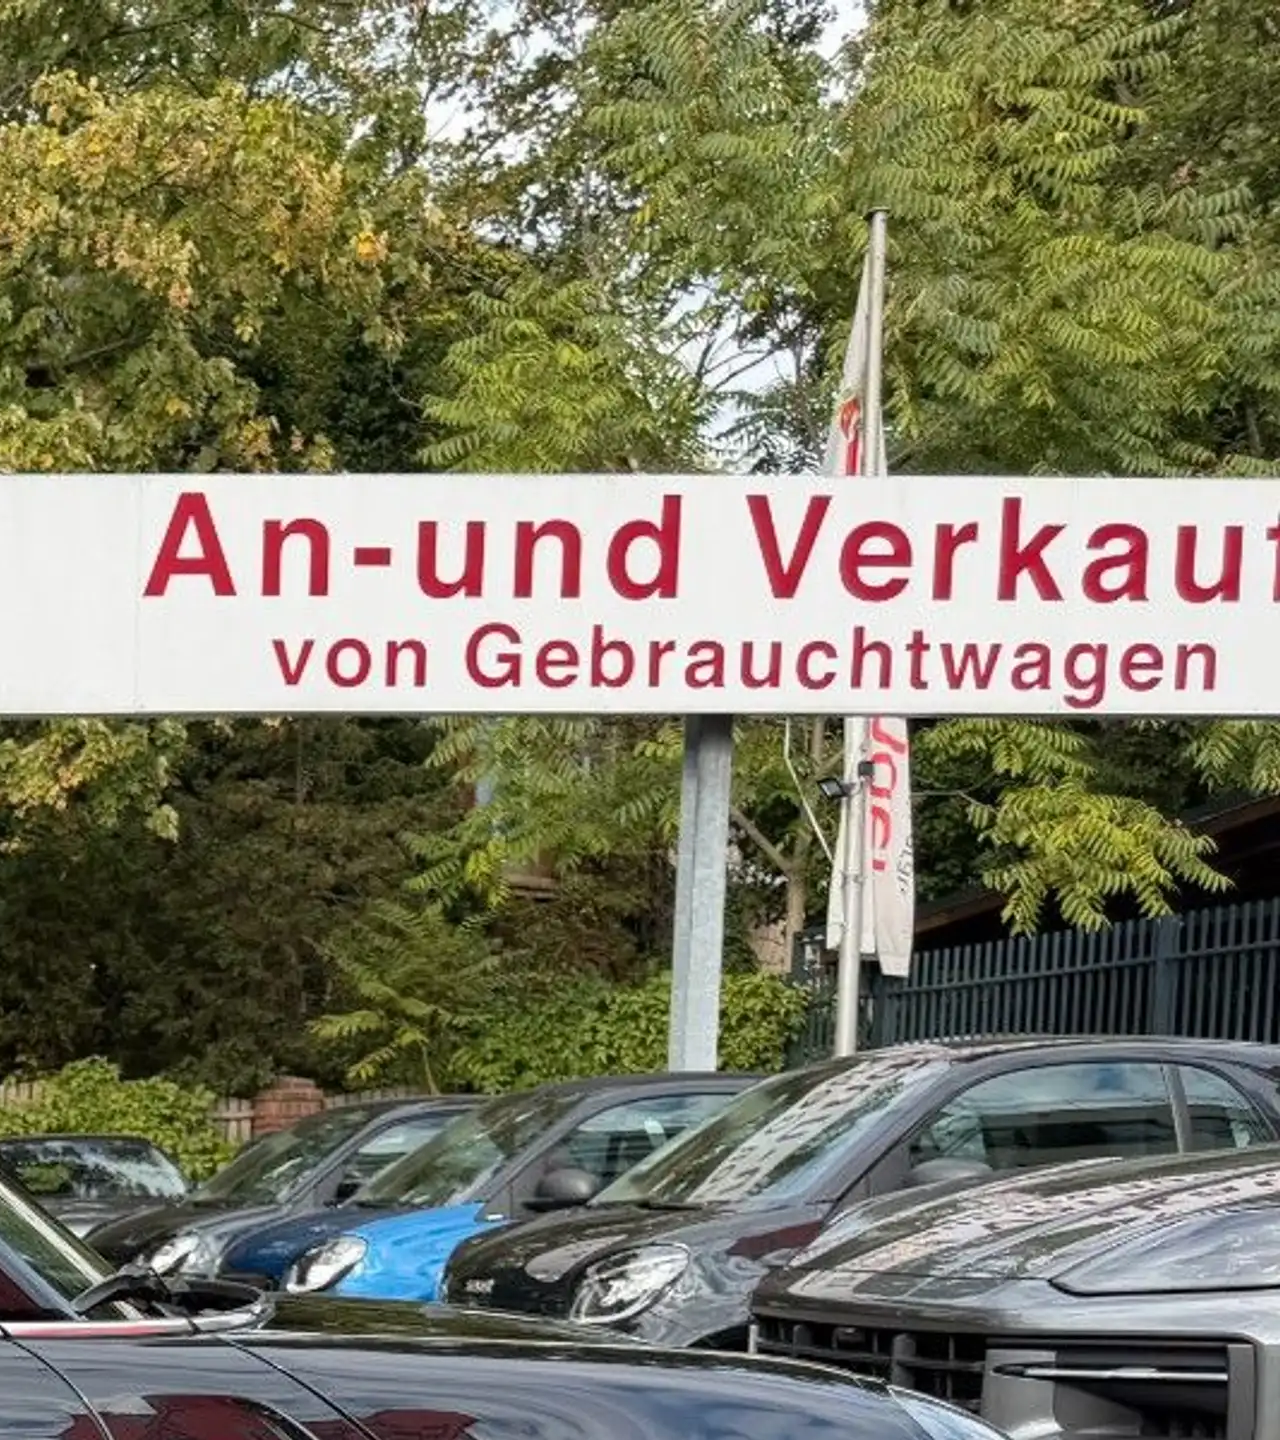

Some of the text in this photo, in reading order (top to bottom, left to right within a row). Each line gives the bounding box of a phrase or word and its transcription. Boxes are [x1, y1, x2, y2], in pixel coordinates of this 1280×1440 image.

[144, 492, 1280, 604] An-und Verkau
[273, 622, 1217, 708] von Gebrauchtwagen
